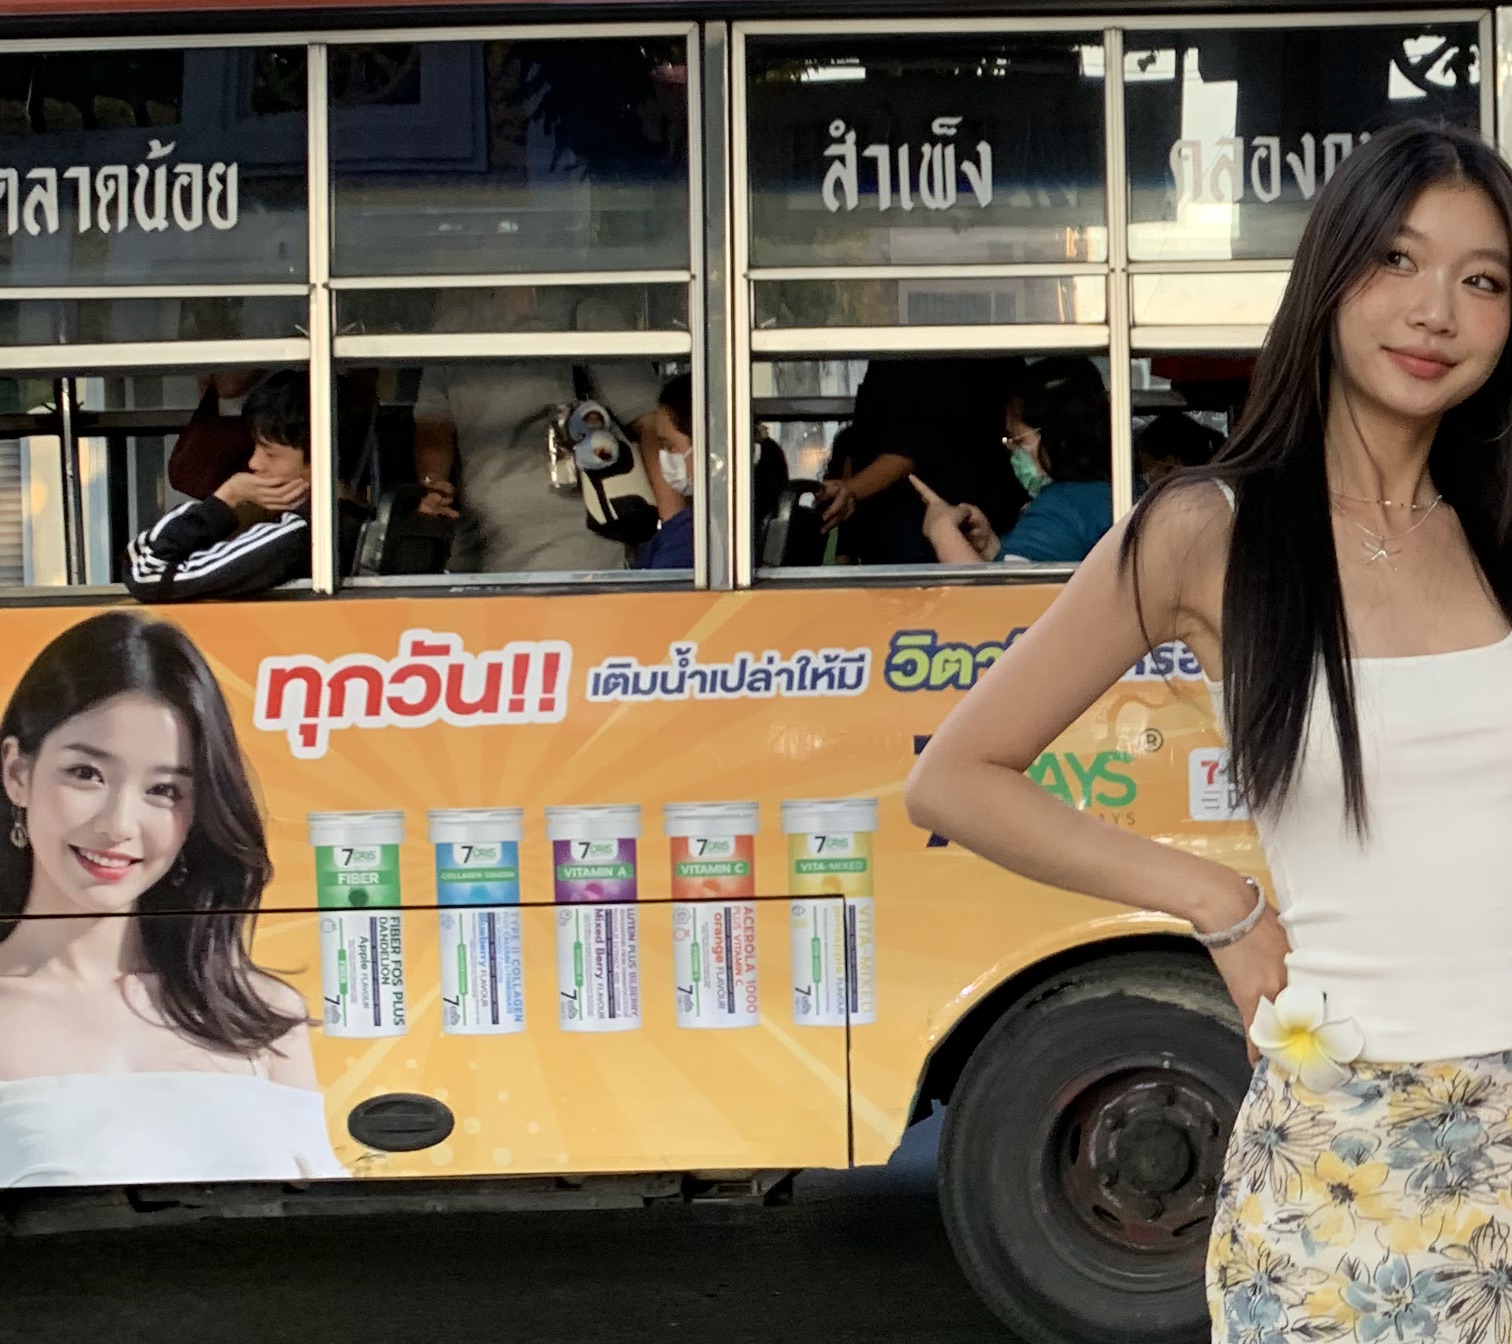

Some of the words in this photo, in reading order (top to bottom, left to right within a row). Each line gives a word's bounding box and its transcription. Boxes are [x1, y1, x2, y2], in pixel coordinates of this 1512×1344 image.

[822, 116, 993, 213] สำเพ็ง
[1169, 132, 1371, 204] คลอง
[265, 640, 561, 748] ทุกวัน!!
[591, 647, 867, 697] เติมน้ำเปล่าให้มี
[1027, 751, 1138, 808] AYS
[338, 872, 379, 885] FIBER
[563, 866, 614, 878] VITAMIN
[617, 866, 628, 877] A
[680, 863, 732, 875] VITAMIN
[734, 862, 745, 873] C
[390, 917, 400, 955] FIBER
[594, 909, 604, 943] Mixed
[712, 913, 724, 963] orange
[743, 907, 754, 972] ACEROLA
[358, 936, 370, 970] Apple
[379, 917, 390, 985] DANDELION
[594, 948, 605, 979] Berry
[628, 945, 636, 969] PLUS
[734, 934, 742, 975] VITAMIN
[392, 960, 402, 986] FOS
[480, 969, 488, 1007] FLAVOUR
[512, 959, 523, 1022] COLLAGEN
[716, 967, 725, 1009] FLAVOUR
[393, 992, 404, 1026] PLUS
[746, 980, 757, 1013] 1000
[836, 977, 844, 1015] FLAVOUR
